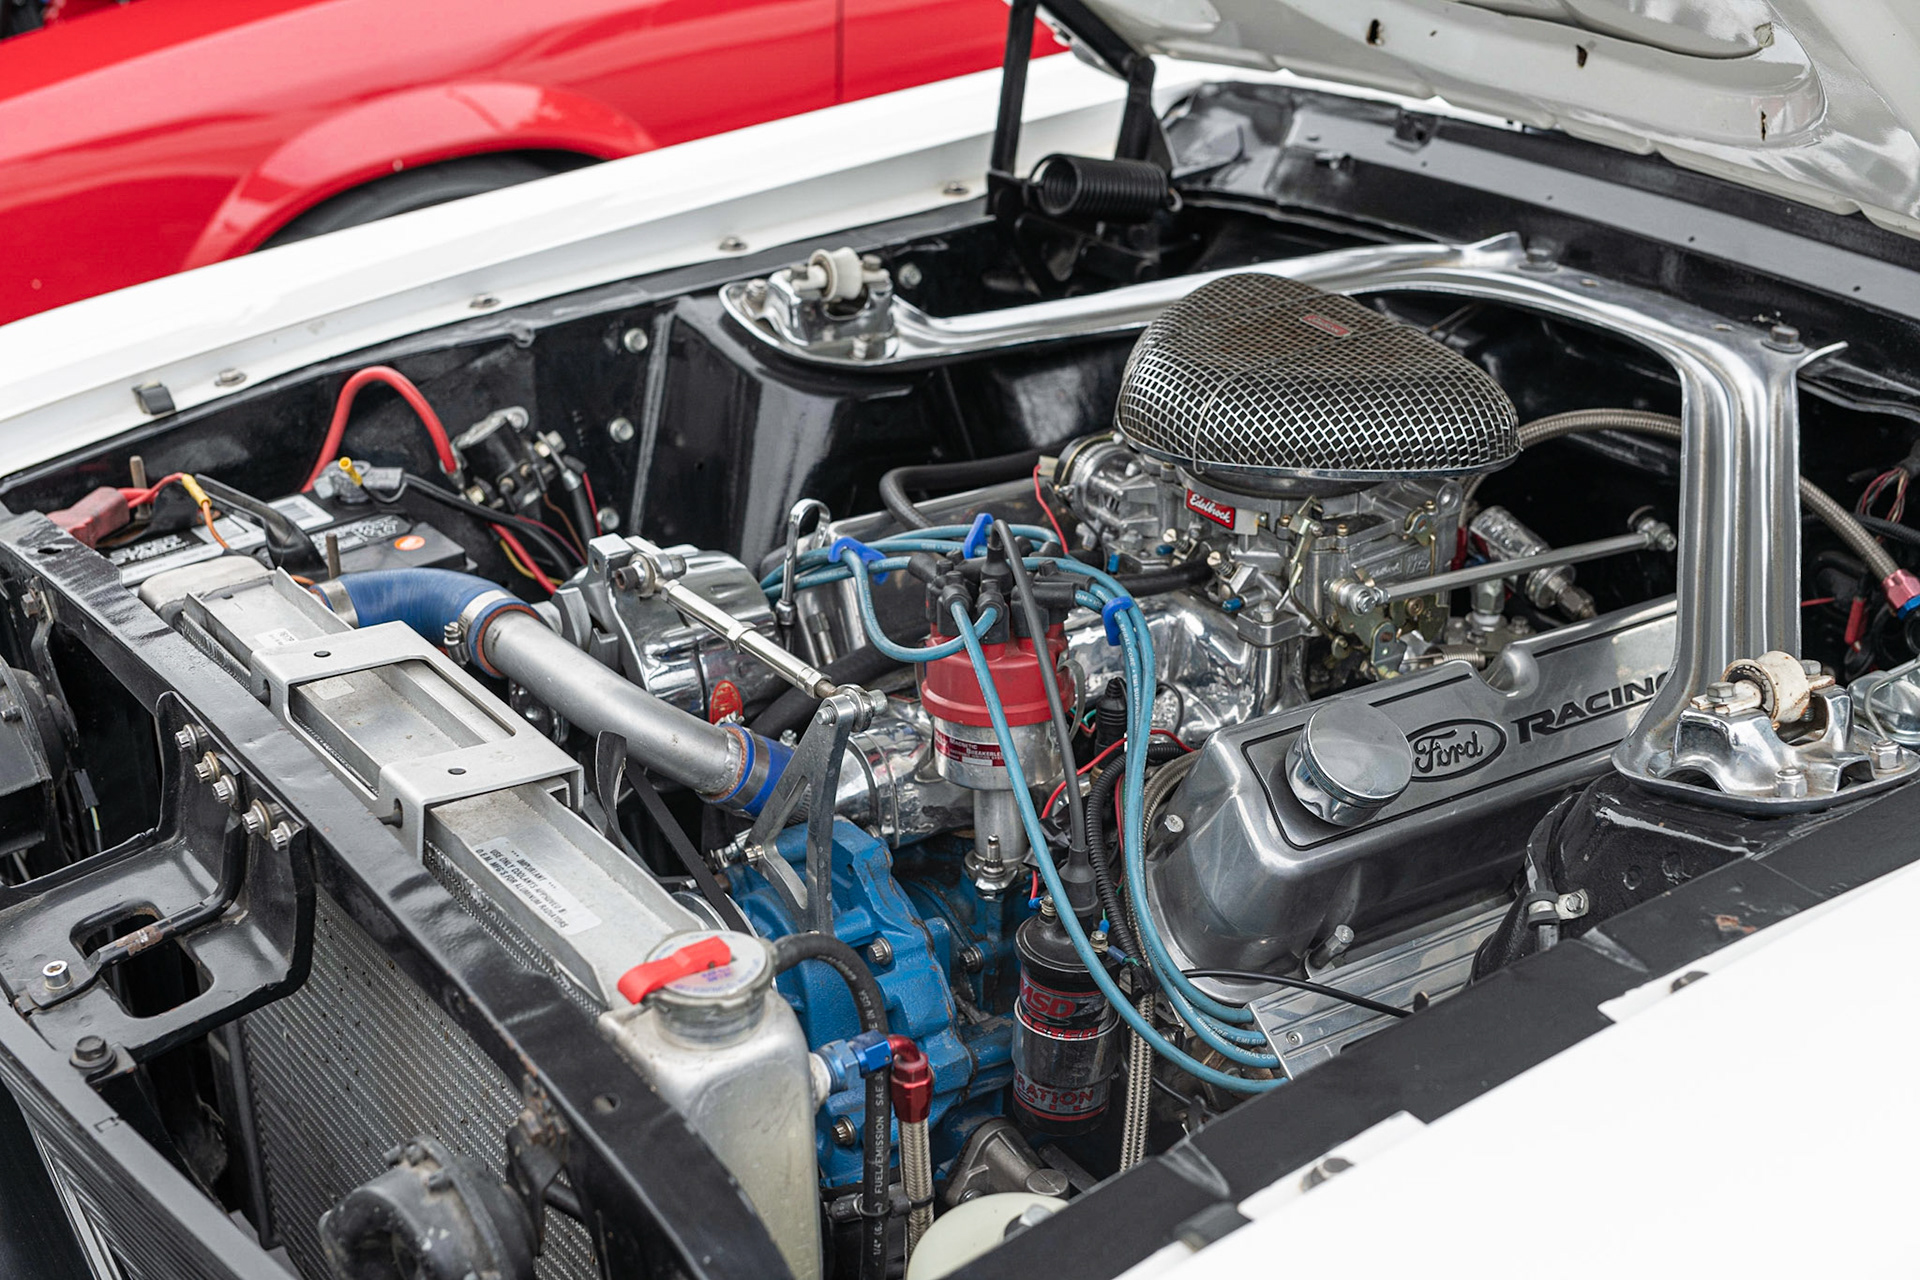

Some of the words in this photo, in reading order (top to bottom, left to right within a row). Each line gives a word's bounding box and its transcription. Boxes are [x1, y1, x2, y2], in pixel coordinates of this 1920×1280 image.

[1190, 493, 1231, 523] Edelbrock
[1127, 648, 1136, 666] CORE
[1413, 729, 1484, 774] Ford
[858, 989, 872, 1007] USA
[1020, 977, 1076, 1018] MSD
[1235, 1046, 1260, 1059] SPIRAL
[875, 1086, 884, 1106] SAE
[874, 1116, 884, 1194] FUEL/EMISSION
